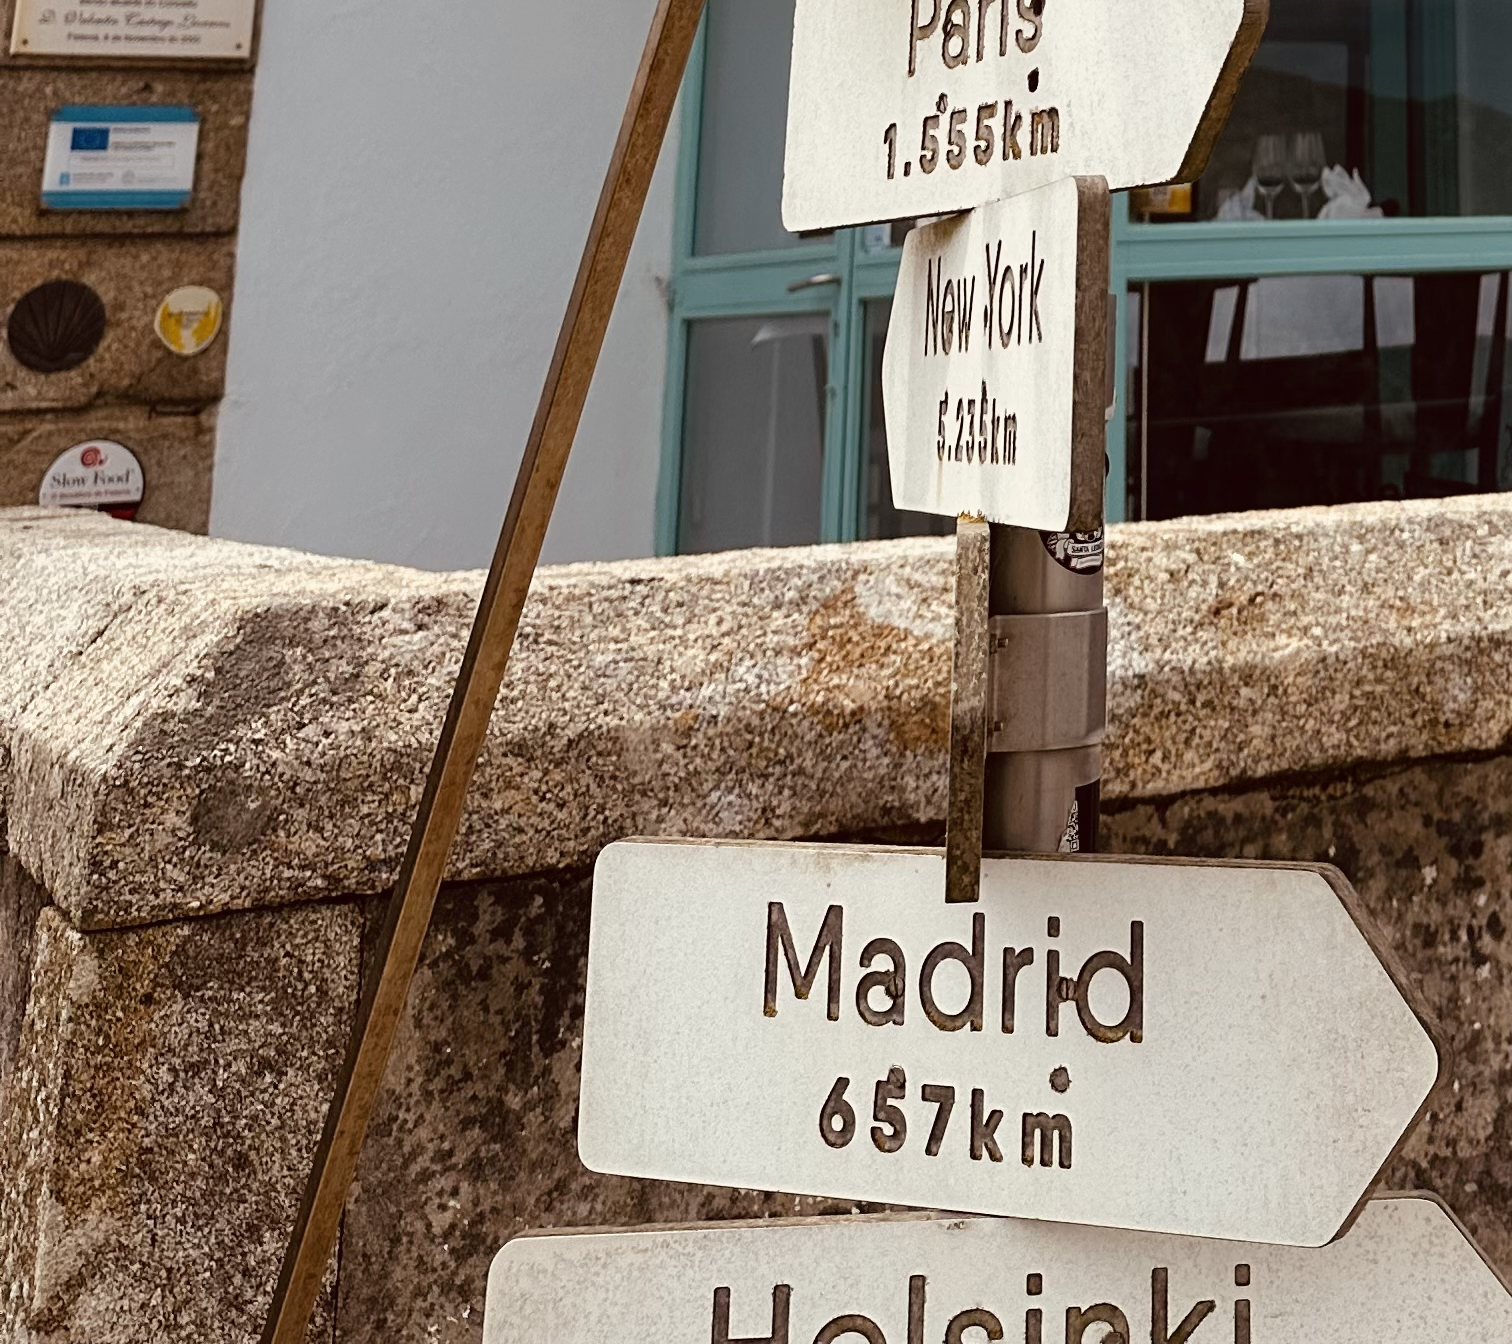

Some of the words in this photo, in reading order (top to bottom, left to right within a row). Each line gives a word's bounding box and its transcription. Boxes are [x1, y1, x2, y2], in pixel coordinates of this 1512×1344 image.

[882, 100, 1061, 182] 1.555km
[923, 255, 975, 357] New
[984, 229, 1045, 351] York
[936, 392, 1018, 467] 5.235km
[762, 901, 1144, 1043] Madrid
[817, 1074, 1074, 1169] 657km
